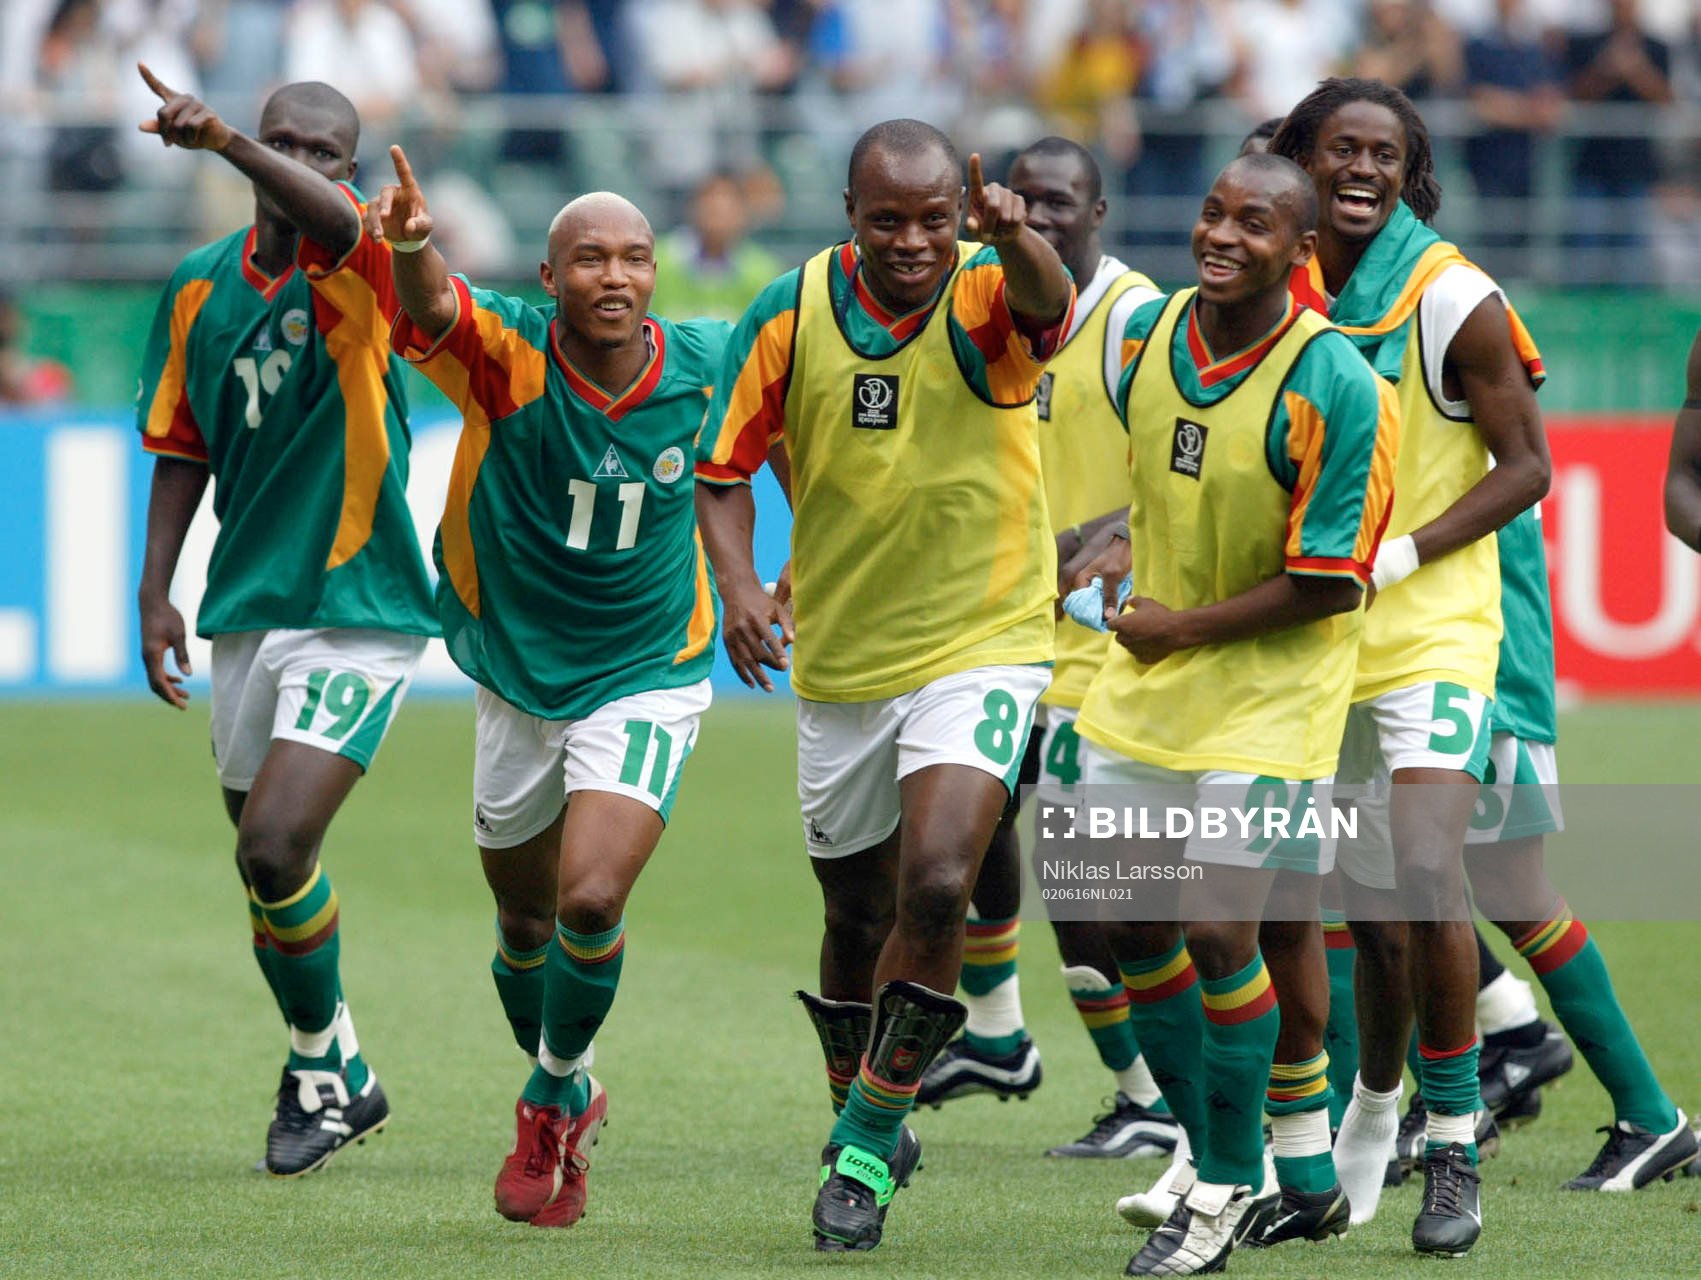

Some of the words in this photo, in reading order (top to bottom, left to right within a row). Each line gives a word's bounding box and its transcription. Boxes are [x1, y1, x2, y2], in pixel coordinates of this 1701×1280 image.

[565, 479, 646, 551] 11
[294, 667, 370, 741] 19
[974, 688, 1019, 766] 8
[1428, 681, 1474, 755] 5
[619, 720, 672, 800] 11
[1045, 721, 1081, 793] 4
